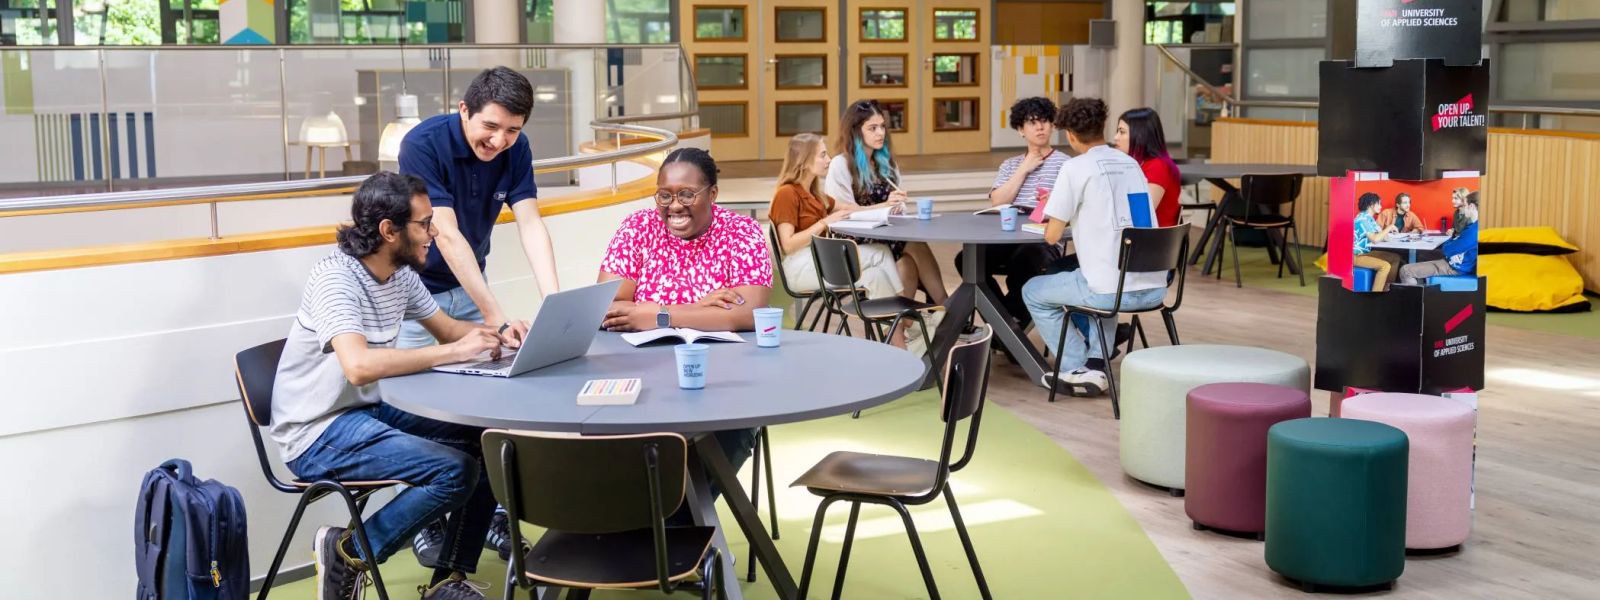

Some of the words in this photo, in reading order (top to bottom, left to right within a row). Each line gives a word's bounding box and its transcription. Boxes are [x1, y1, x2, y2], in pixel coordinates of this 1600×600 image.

[1402, 8, 1444, 17] UNIVERSITY
[1380, 19, 1391, 27] OF
[1392, 18, 1422, 27] APPLIED
[1423, 17, 1458, 26] SCIENCES
[1438, 103, 1458, 115] OPEN
[1437, 116, 1458, 128] YOUR
[1459, 114, 1485, 127] TALENT!
[1445, 335, 1468, 346] UNIVERSITY
[1433, 349, 1441, 358] OF
[1440, 346, 1457, 356] APPLIED
[1457, 342, 1474, 352] SCIENCES
